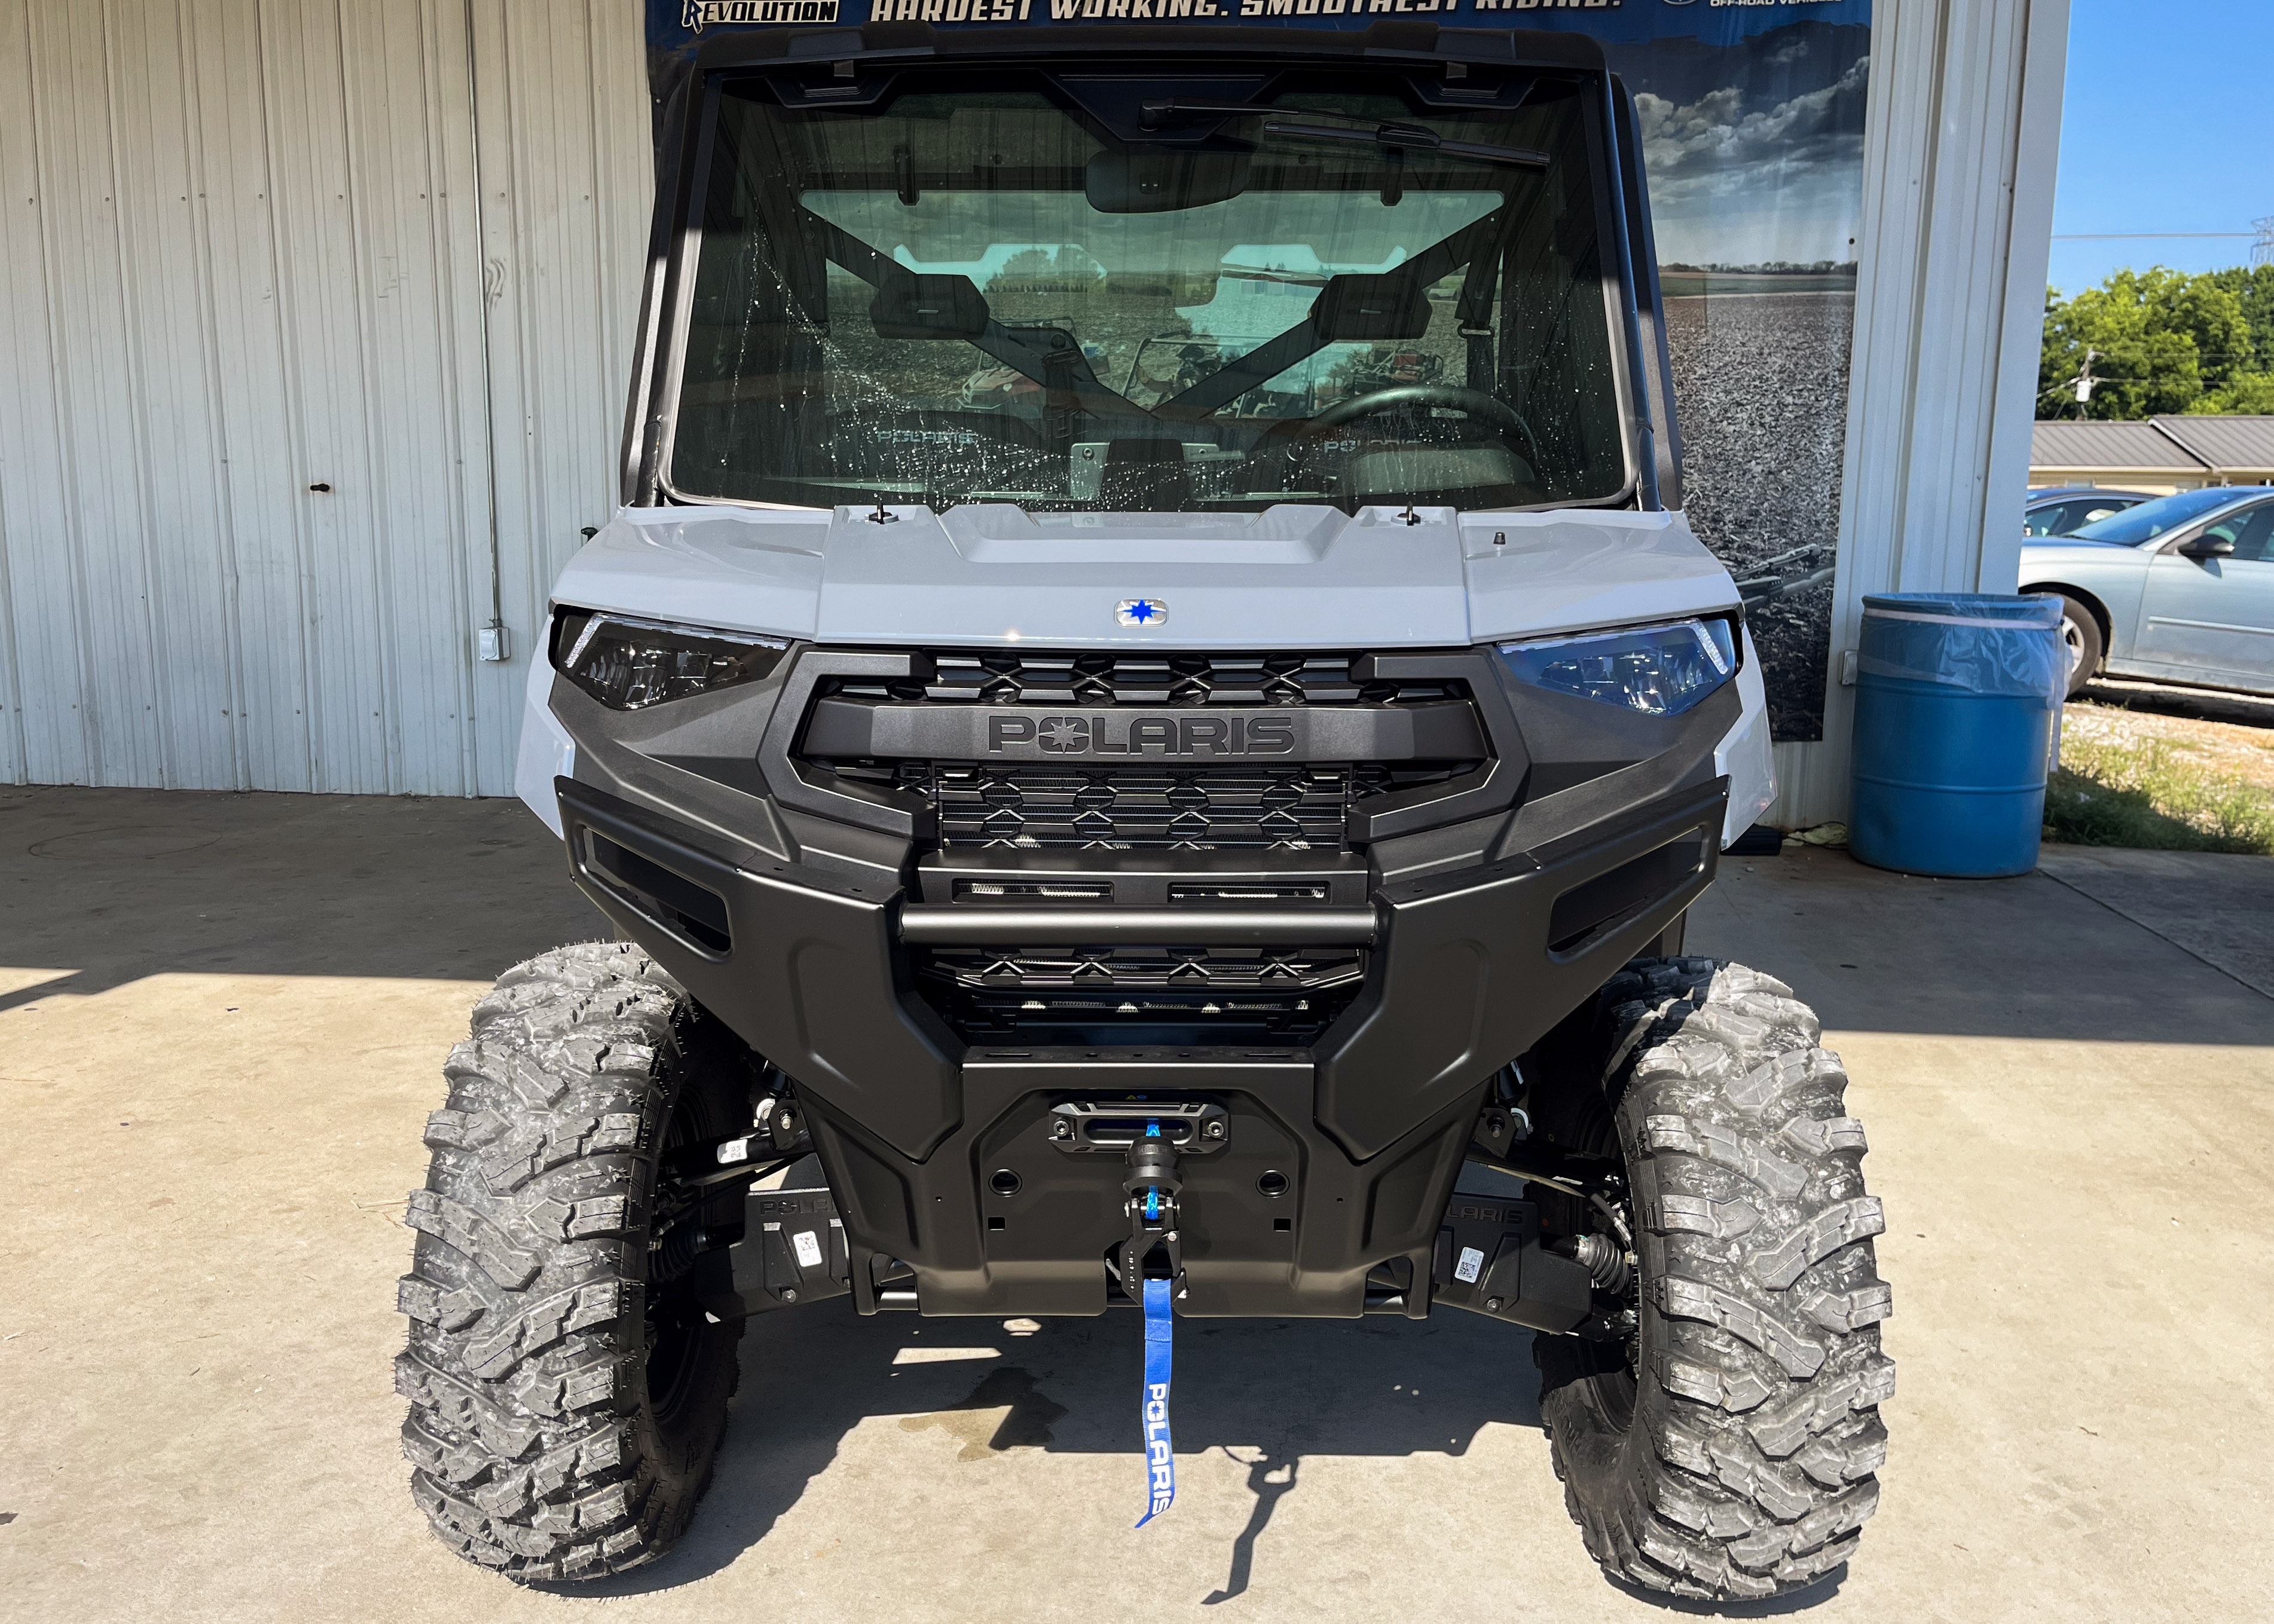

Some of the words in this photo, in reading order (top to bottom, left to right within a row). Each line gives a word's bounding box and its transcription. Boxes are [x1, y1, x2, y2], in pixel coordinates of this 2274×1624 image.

[682, 0, 838, 34] REVOLUTION
[870, 0, 1031, 22] HARDEST
[1051, 0, 1228, 19] WORKING.
[988, 715, 1295, 756] POLARIS
[759, 1198, 837, 1216] POLA
[1447, 1203, 1523, 1225] LARIS
[1147, 1383, 1172, 1515] POLARIS
